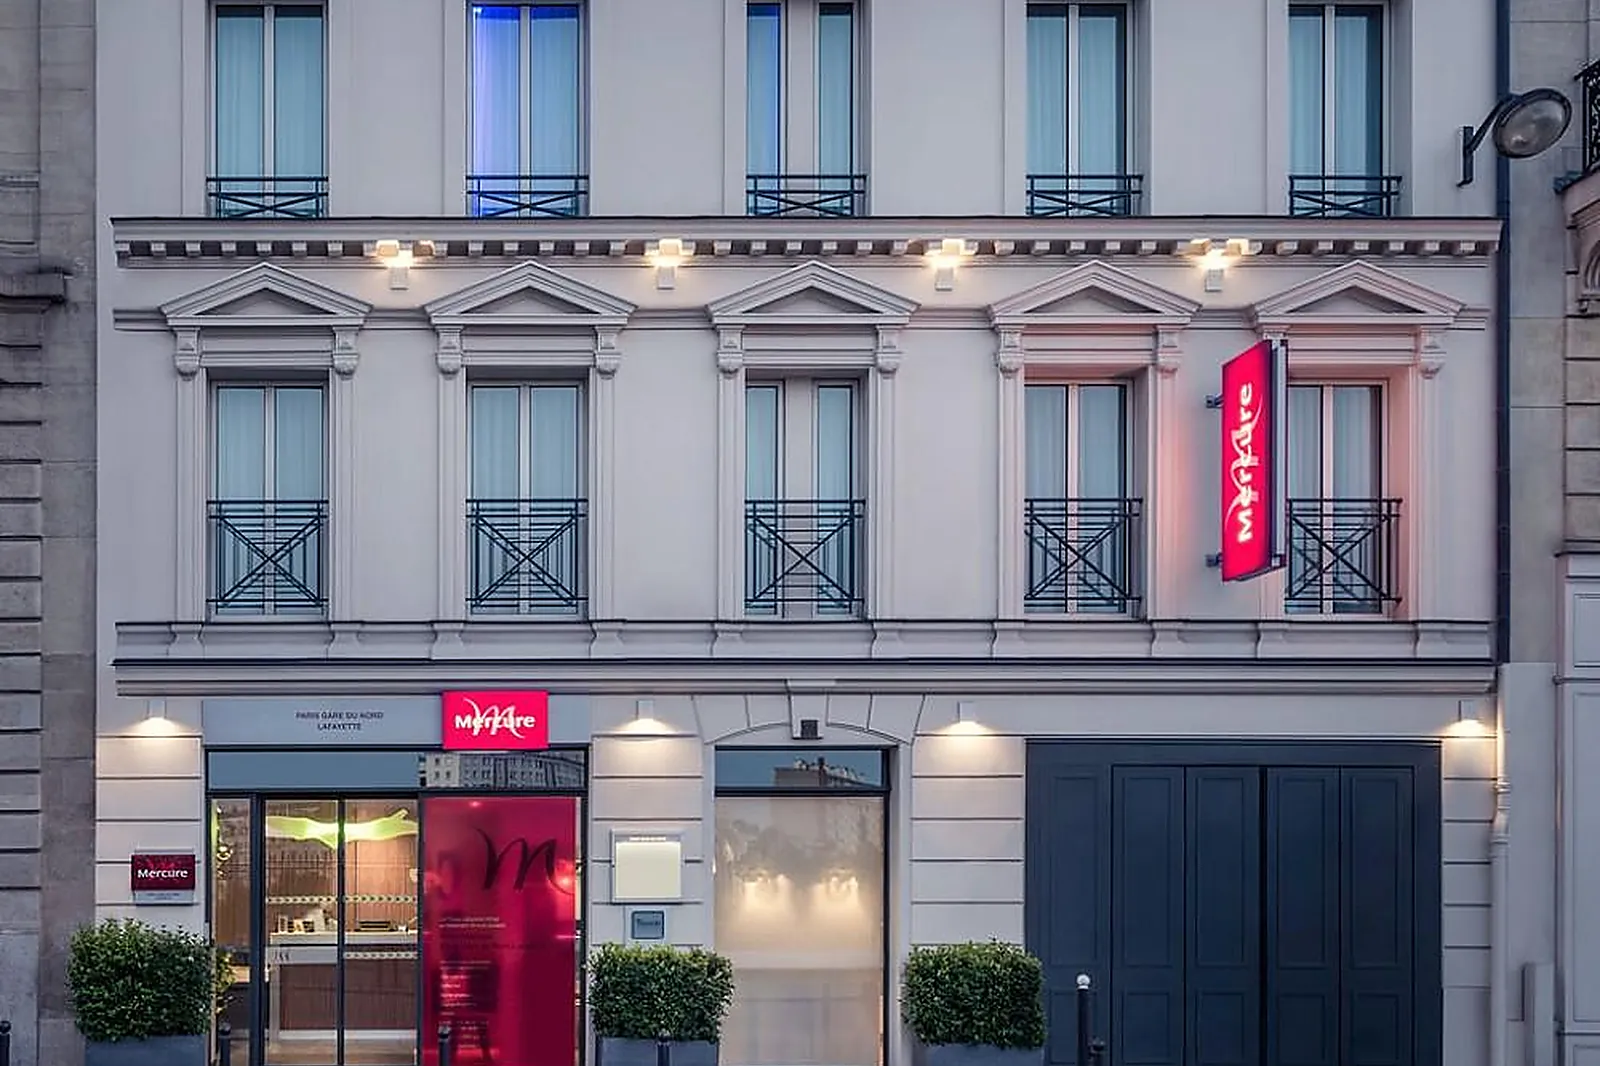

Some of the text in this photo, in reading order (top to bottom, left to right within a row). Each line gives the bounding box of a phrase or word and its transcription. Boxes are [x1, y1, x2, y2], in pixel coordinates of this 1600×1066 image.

[1237, 382, 1253, 543] Mercure
[317, 723, 361, 731] LAFAYETTE
[454, 714, 536, 730] Mercure
[137, 869, 189, 878] Mercure
